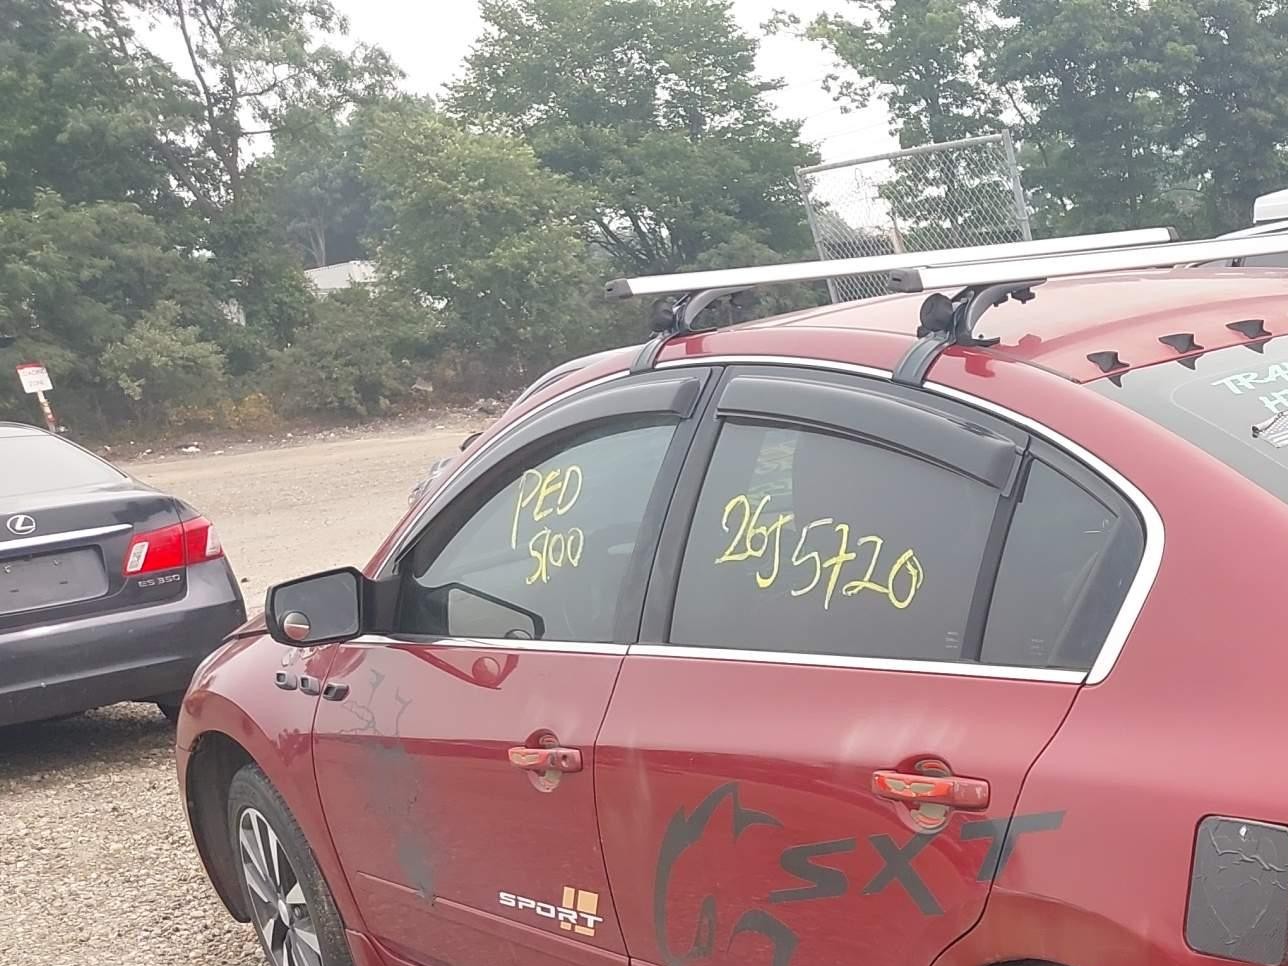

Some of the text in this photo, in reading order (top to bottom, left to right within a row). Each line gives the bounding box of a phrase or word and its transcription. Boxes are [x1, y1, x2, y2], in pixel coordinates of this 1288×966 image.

[511, 465, 582, 550] PED
[138, 574, 181, 588] ES 350
[768, 810, 1066, 918] SXT
[499, 891, 604, 929] SPORT
